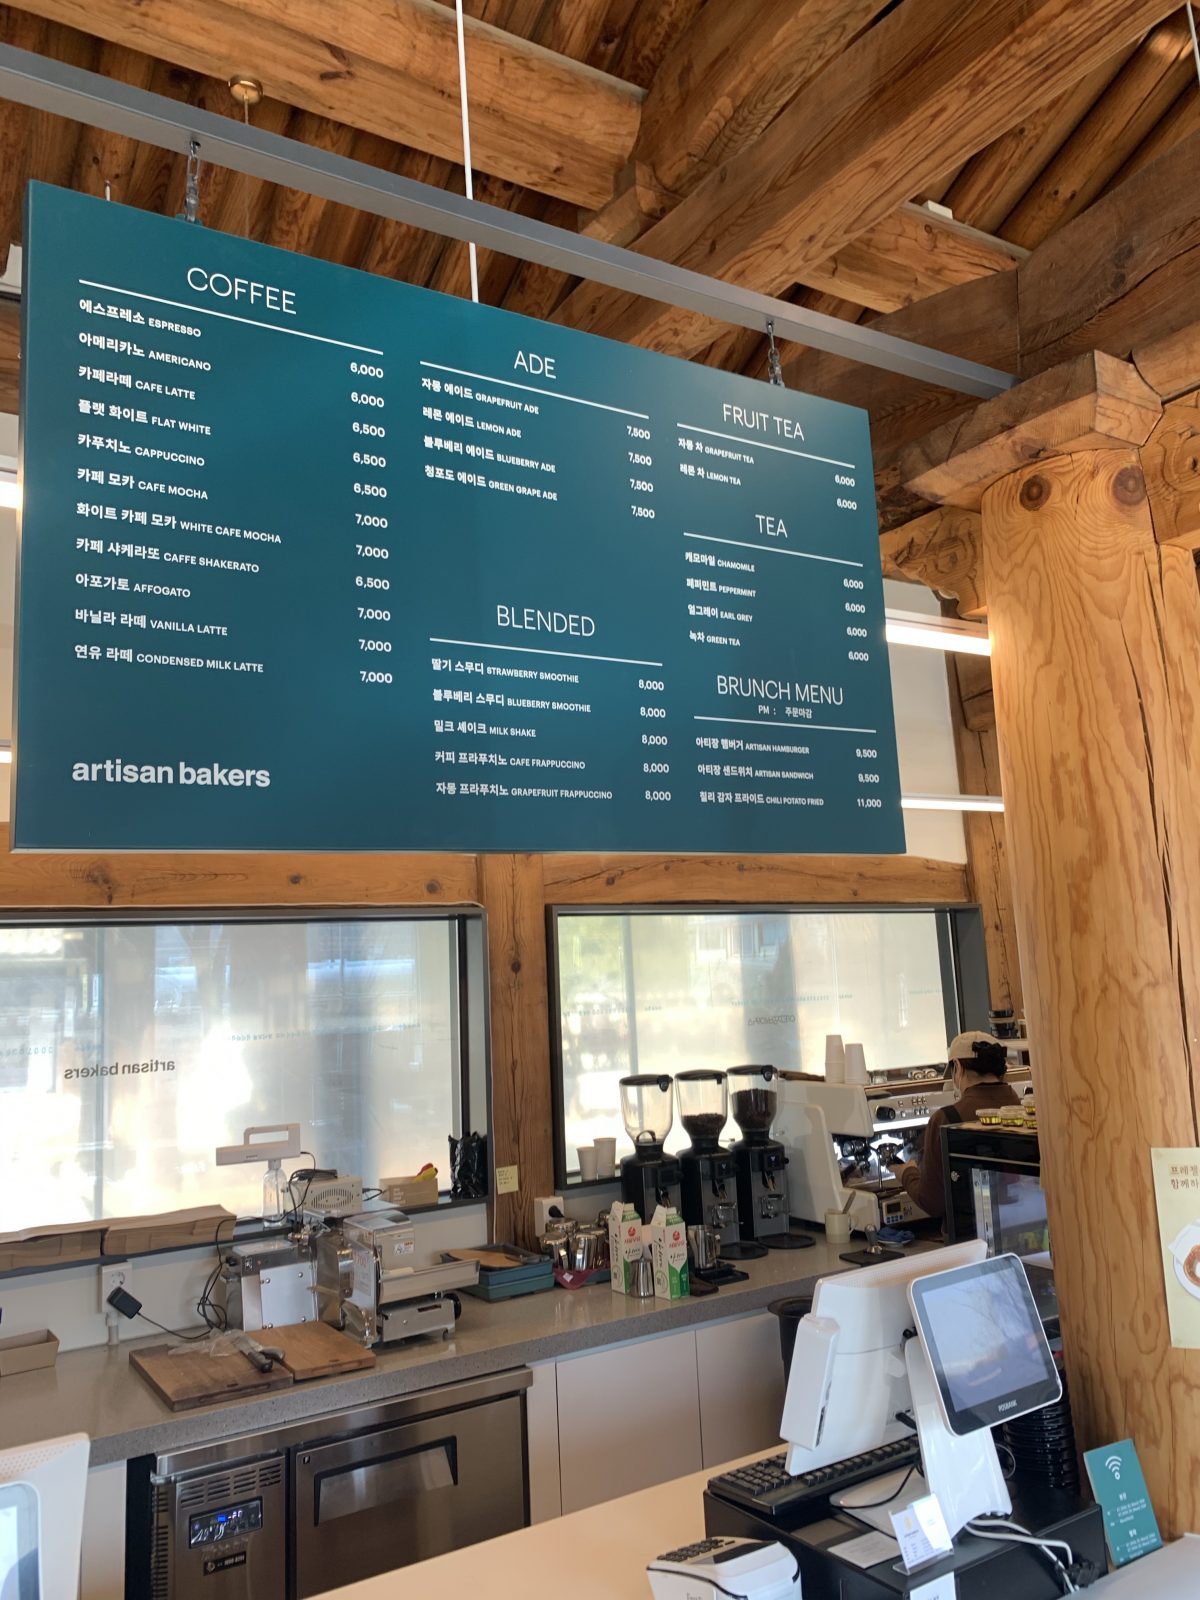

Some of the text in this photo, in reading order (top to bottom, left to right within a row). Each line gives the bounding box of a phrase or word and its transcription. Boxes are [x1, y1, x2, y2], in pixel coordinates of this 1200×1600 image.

[187, 268, 296, 314] COFFEE
[79, 299, 201, 337] 에스프레소 ESPRESSO
[79, 333, 211, 370] 아메리카노 AMERICANO
[350, 362, 383, 378] 6,000
[514, 351, 556, 379] ADE
[79, 366, 195, 400] 카페라떼 CAFE LATTE
[351, 392, 384, 407] 6,000
[422, 378, 539, 414] 자몽 에이드 GRAPEFRUIT ADE
[78, 399, 211, 435] 플랫 화이트 FLAT WHITE
[423, 407, 521, 438] 레몬 에이드 LEMON ADE
[723, 404, 804, 441] FRUIT TEA
[353, 422, 385, 437] 6,500
[627, 426, 650, 439] 7,500
[78, 434, 204, 466] 카푸치노 CAPPUCCINO
[424, 435, 555, 473] 블루베리 에이드 BLUEBERRY ADE
[678, 438, 754, 464] 자몽 차 GRAPEFRUIT TEA
[353, 452, 386, 467] 6,500
[628, 452, 652, 466] 7,500
[680, 464, 741, 485] 레몬 차 LEMON TEA
[835, 475, 855, 487] 6,000
[78, 468, 208, 499] 카페 모카 CAFE MOCHA
[354, 483, 387, 497] 6,500
[425, 465, 557, 501] 청포도 에이드 GREEN GRAPE ADE
[630, 479, 653, 492] 7,500
[837, 498, 857, 510] 6,000
[631, 506, 655, 518] 7,500
[77, 503, 281, 543] 화이트 카페 모카 WHITE CAFE MOCHA
[355, 514, 388, 528] 7,000
[755, 515, 787, 538] TEA
[77, 538, 259, 572] 카페 샤케라또 CAFFE SHAKERATO
[356, 545, 388, 559] 7,000
[717, 559, 754, 572] CHAMOMILE
[76, 574, 190, 597] 아포가토 AFFOGATO
[356, 576, 389, 590] 6,500
[844, 578, 863, 589] 6,000
[719, 585, 756, 597] PEPPERMINT
[358, 608, 390, 621] 7,000
[688, 604, 752, 622] 얼그레이 EARL GREY
[845, 603, 865, 613] 6,000
[76, 609, 227, 635] 바닐라 라떼 VANILLA LATTE
[497, 605, 595, 636] BLENDED
[689, 631, 740, 646] 녹차 GREEN TEA
[847, 627, 867, 637] 6,000
[359, 639, 391, 652] 7,000
[75, 645, 263, 672] 연유 라떼 CONDENSED MILK LATTE
[848, 651, 869, 661] 6,000
[360, 671, 392, 683] 7,000
[432, 658, 579, 683] 딸기 스무디 STRAWBERRY SMOOTHIE
[639, 679, 664, 690] 8,000
[717, 675, 843, 705] BRUNCH MENU
[433, 689, 591, 712] 블루베리 스무디 BLUEBERRY SMOOTHIE
[640, 707, 665, 718] 8,000
[759, 705, 769, 714] PM
[785, 707, 812, 718] 주문마감
[434, 720, 454, 732] 밀크
[490, 727, 508, 735] MILK
[510, 728, 536, 737] SHAKE
[642, 735, 667, 745] 8,000
[696, 737, 809, 754] 아티장 햄버거 ARTISAN HAMBURGER
[435, 751, 585, 769] 커피 프라푸치노 CAFE FRAPPUCCINO
[856, 749, 877, 758] 9,500
[72, 759, 270, 787] artisan bakers
[644, 763, 669, 773] 8,000
[698, 764, 721, 775] 아티장
[755, 770, 780, 778] ARTISAN
[782, 771, 813, 779] SANDWICH
[858, 774, 879, 783] 9,500
[436, 782, 612, 799] 자몽 프라푸치노 GRAPEFRUIT FRAPPUCCINO
[645, 790, 671, 801] 8,000
[717, 792, 732, 803] 감자
[735, 793, 764, 804] 프라이드
[784, 797, 806, 805] POTATO
[857, 799, 881, 808] 11,000
